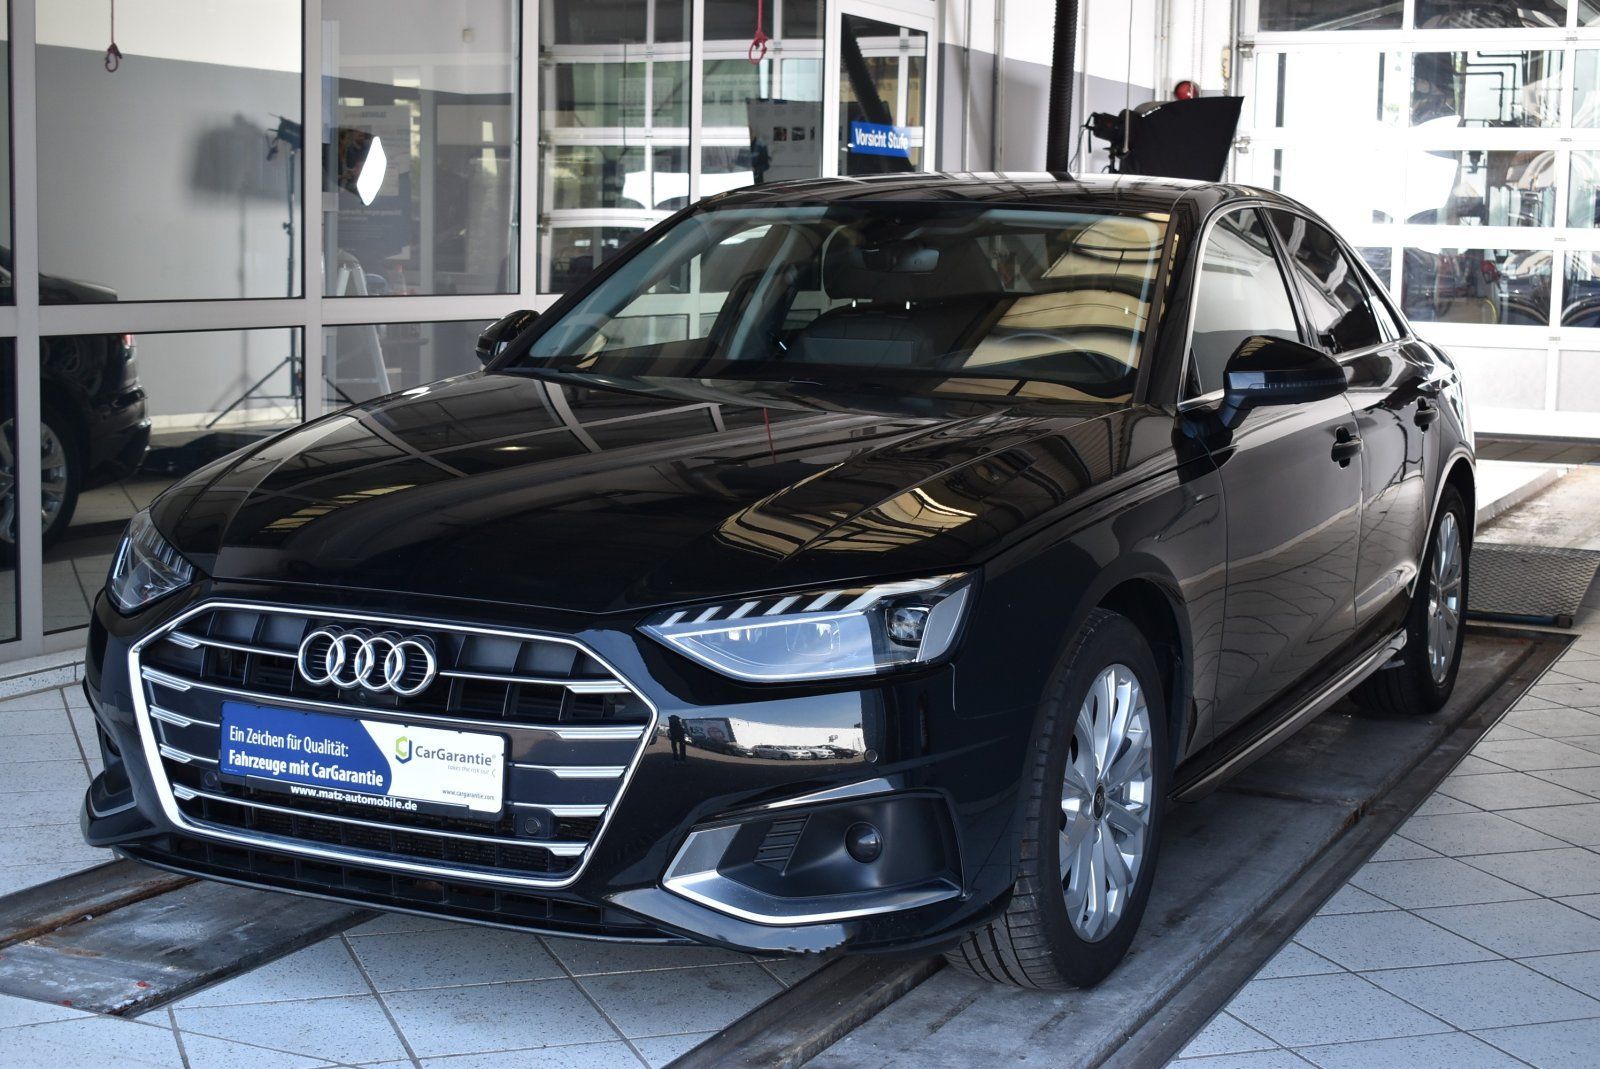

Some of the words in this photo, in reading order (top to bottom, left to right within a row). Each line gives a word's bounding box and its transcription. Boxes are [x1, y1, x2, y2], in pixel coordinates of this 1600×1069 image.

[854, 127, 887, 148] Vorsicht
[887, 131, 909, 150] Stufe
[229, 725, 245, 742] Ein
[246, 728, 285, 748] Zeichen
[286, 733, 302, 751] für
[303, 736, 349, 757] Qualität:
[229, 749, 287, 776] Fahrzeuge
[288, 759, 310, 776] mit
[311, 761, 384, 786] CarGarantie
[415, 745, 492, 766] CarGarantie
[290, 785, 418, 811] www.matz-automobile.de
[442, 789, 495, 801] www.cargarantie.com
